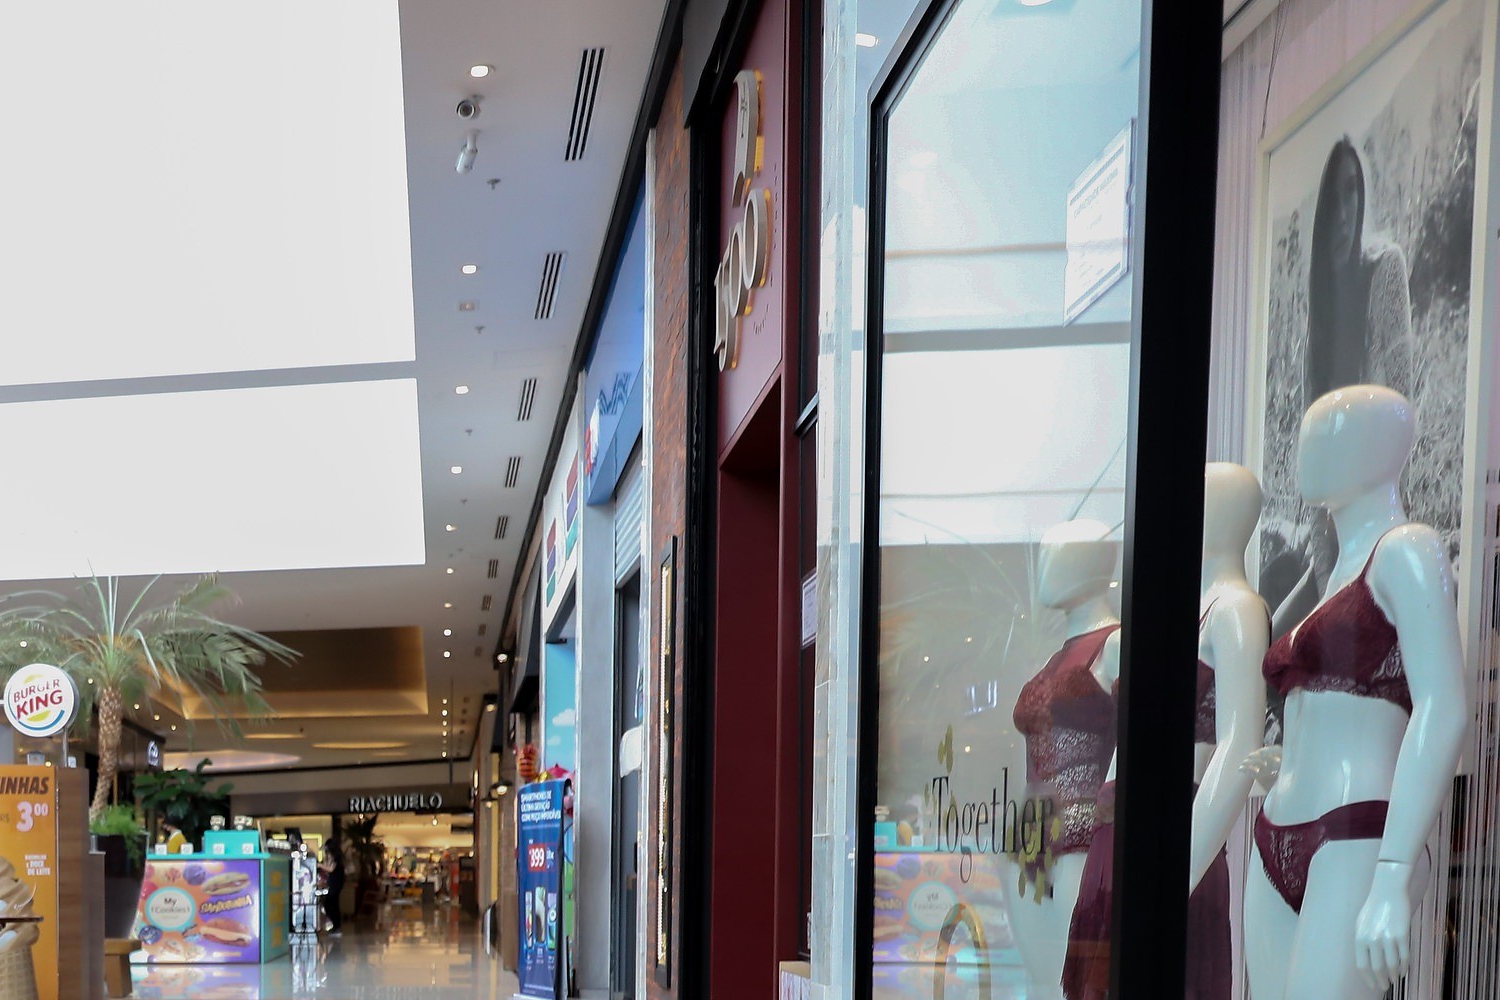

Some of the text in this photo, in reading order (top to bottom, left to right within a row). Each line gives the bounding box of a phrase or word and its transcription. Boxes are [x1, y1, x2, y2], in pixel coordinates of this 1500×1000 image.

[16, 690, 63, 720] KING
[349, 793, 443, 812] RIACHUELO
[931, 767, 1055, 884] Together
